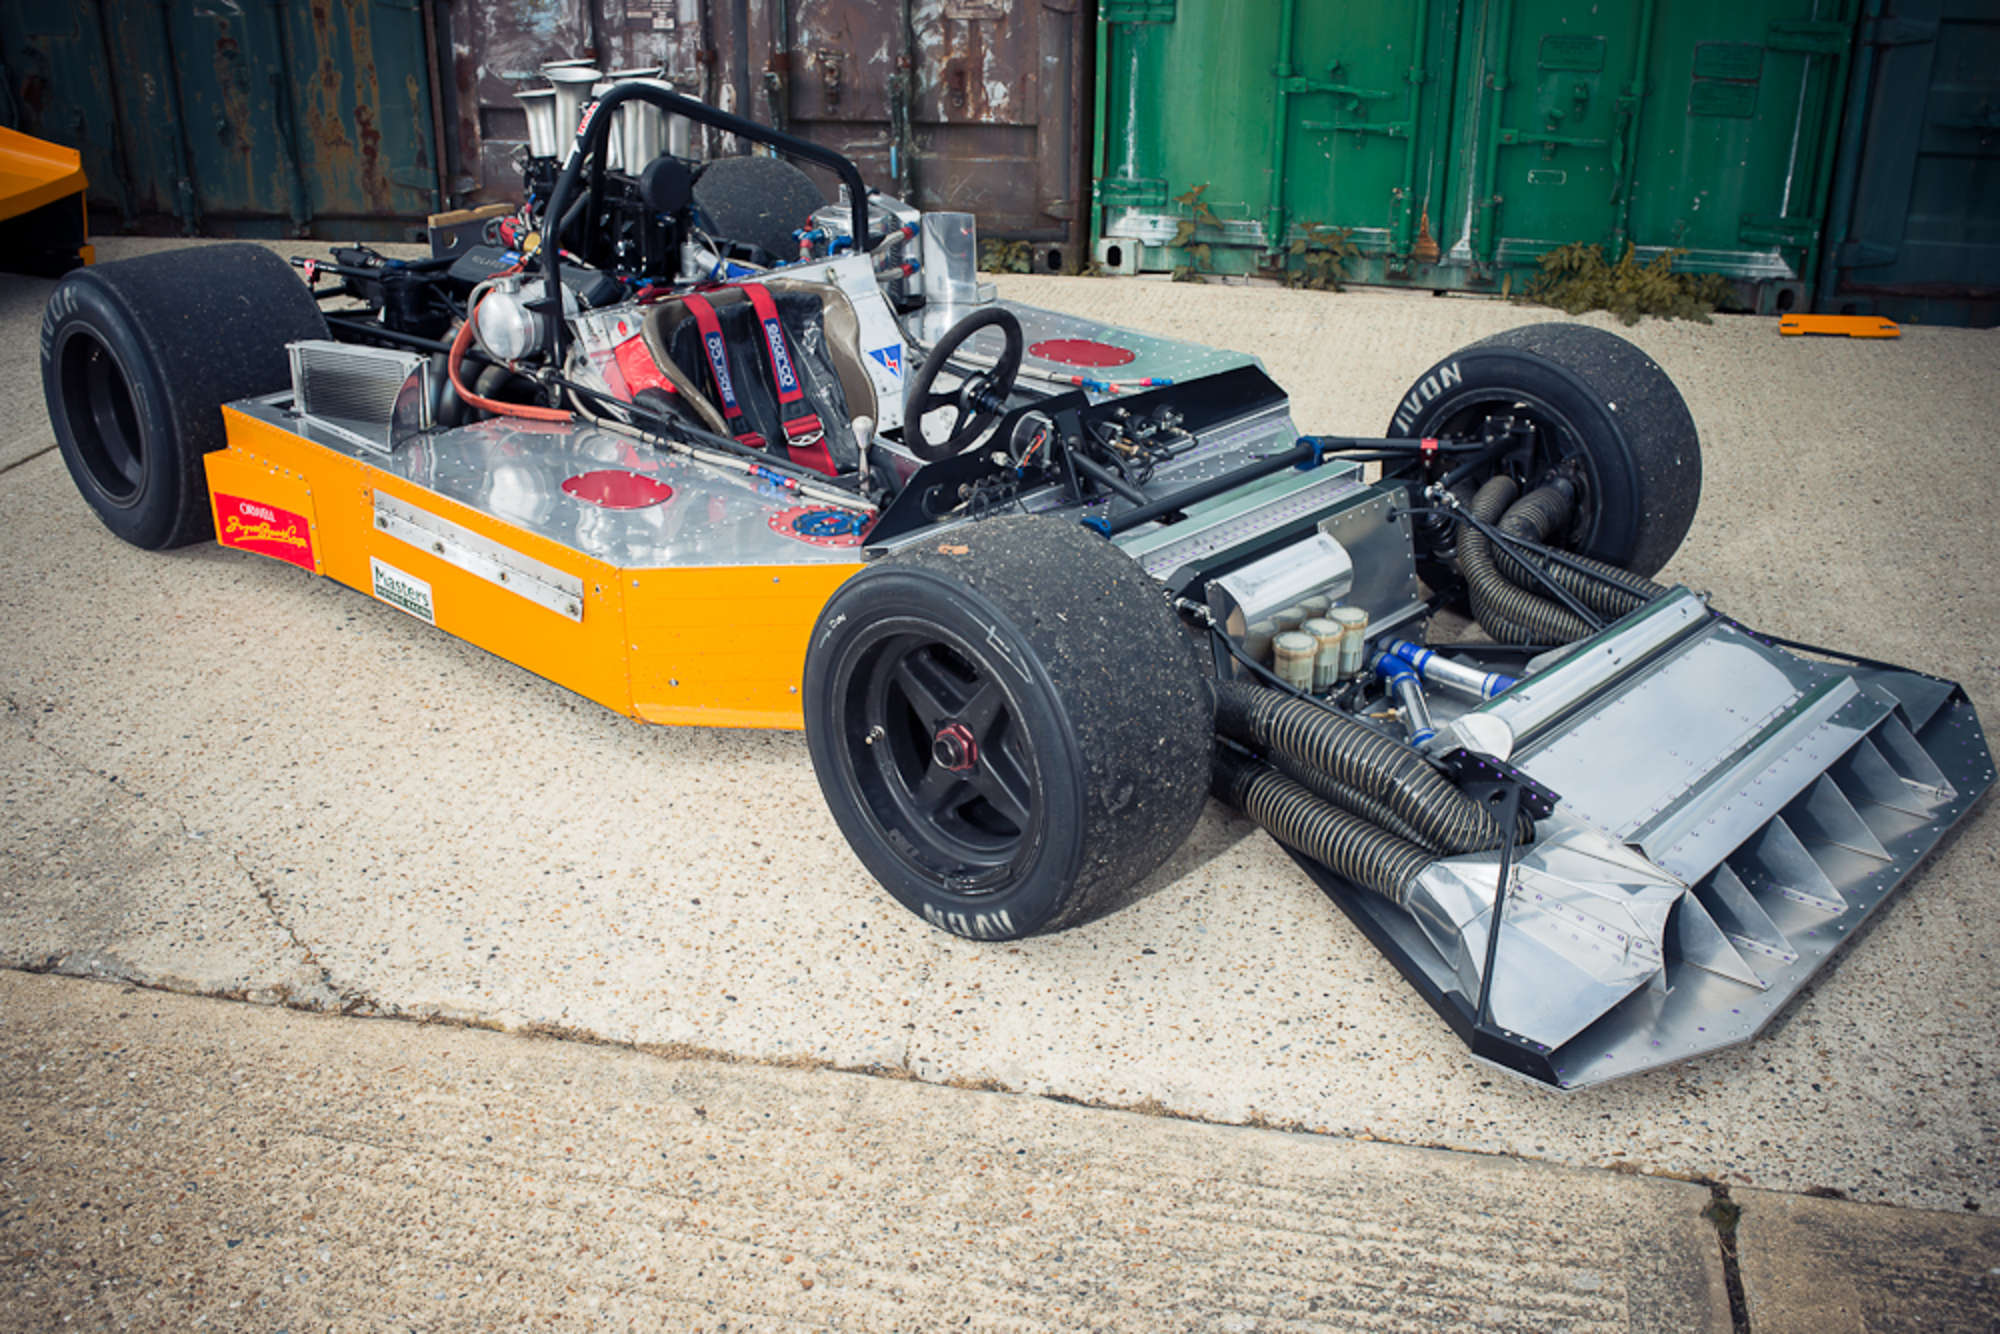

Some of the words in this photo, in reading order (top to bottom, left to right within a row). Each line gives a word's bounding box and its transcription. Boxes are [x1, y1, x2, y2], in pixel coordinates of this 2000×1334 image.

[1395, 361, 1462, 437] AVON
[375, 565, 430, 607] Masters
[923, 903, 1017, 939] AVON
